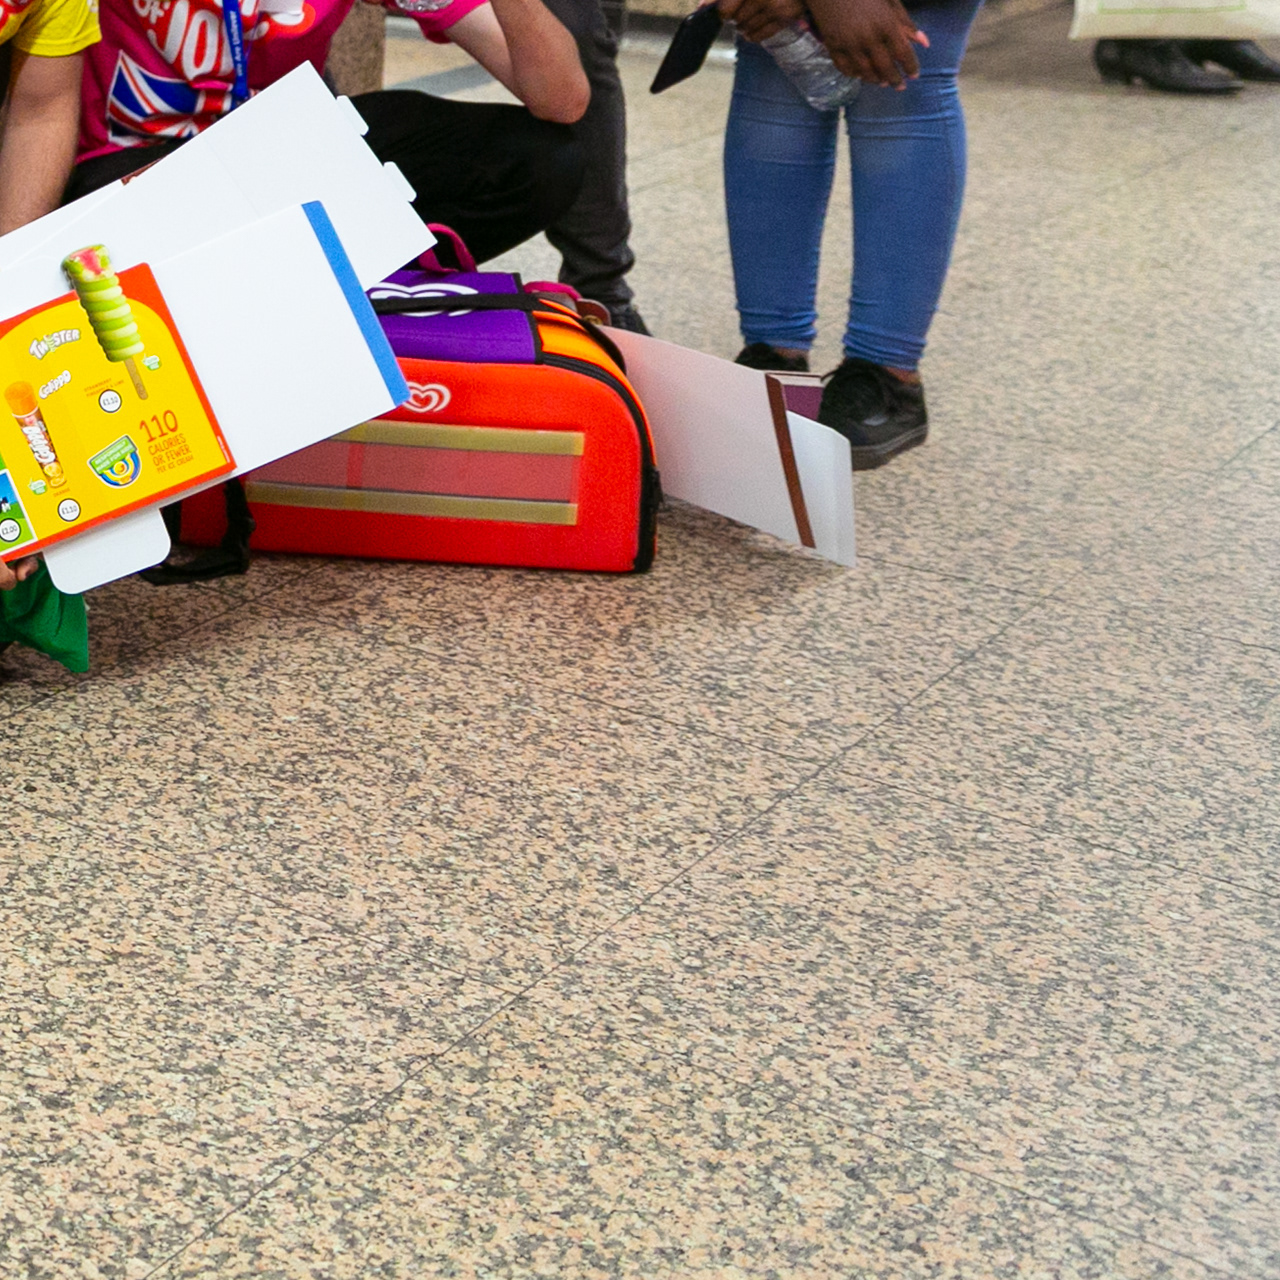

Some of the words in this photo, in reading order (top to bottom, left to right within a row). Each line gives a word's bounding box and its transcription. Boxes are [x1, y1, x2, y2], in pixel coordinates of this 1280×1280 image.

[139, 409, 179, 443] 110
[148, 433, 187, 456] CALORIES
[152, 454, 165, 467] OR
[165, 444, 191, 462] FEWER
